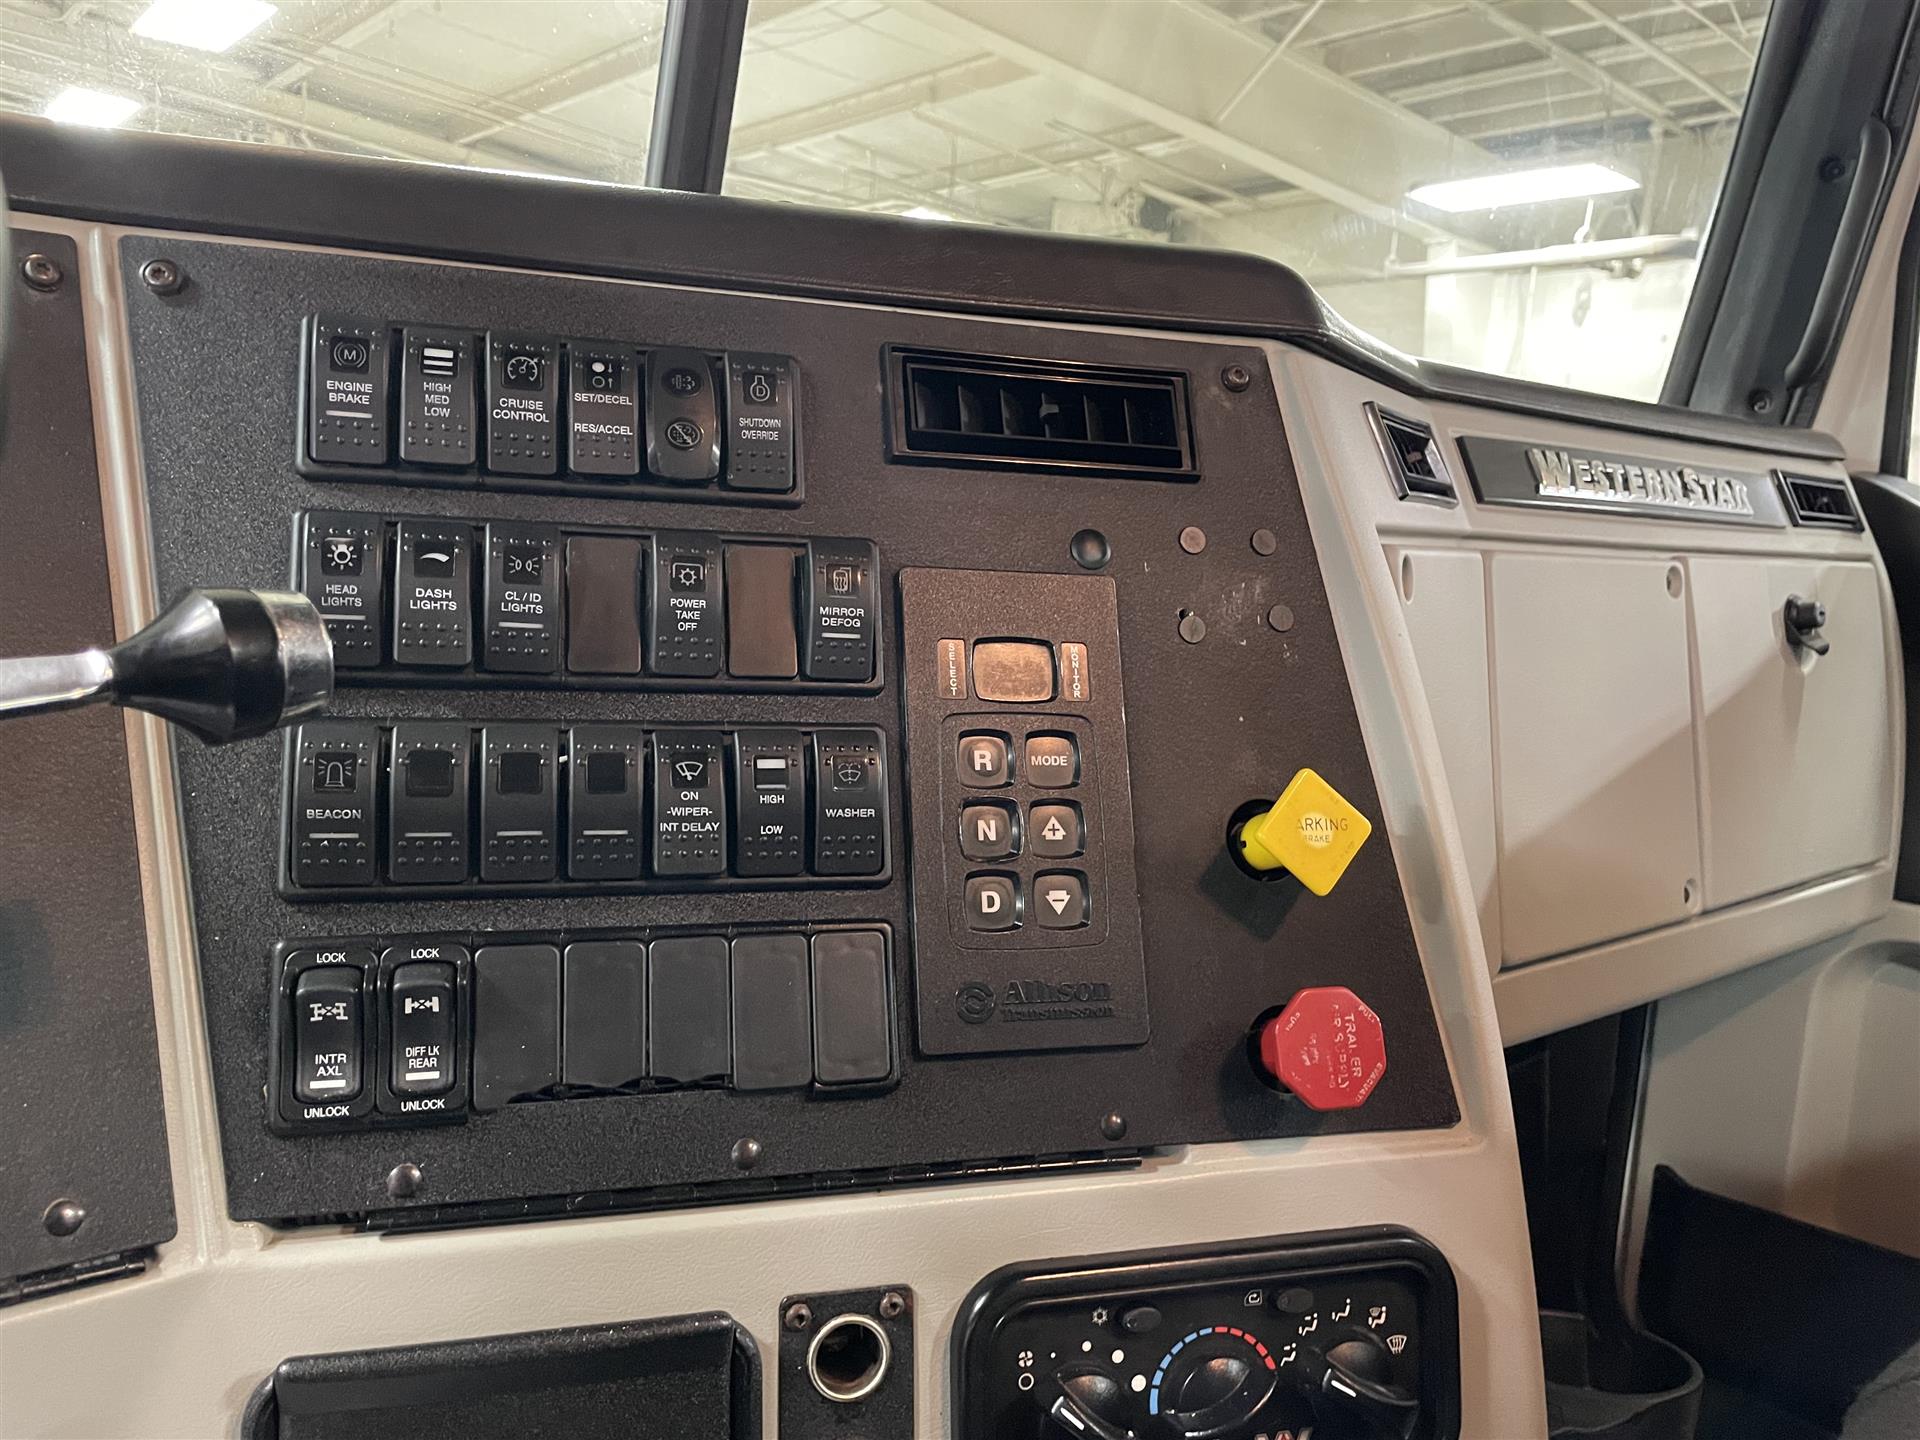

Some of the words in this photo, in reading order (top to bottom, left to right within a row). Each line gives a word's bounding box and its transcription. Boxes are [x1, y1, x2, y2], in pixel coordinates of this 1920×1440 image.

[326, 380, 373, 393] ENGINE
[423, 382, 452, 393] HIGH
[328, 392, 370, 405] BRAKE
[424, 394, 450, 405] MED
[574, 393, 633, 406] SET/DECEL
[499, 398, 544, 411] CRUISE
[424, 406, 451, 418] LOW
[492, 410, 550, 423] CONTROL
[739, 417, 782, 428] SHUTDOWN
[574, 423, 633, 435] RES/ACCEL
[741, 430, 779, 441] OVERRIDE
[325, 584, 358, 595] HEAD
[415, 588, 452, 599] DASH
[321, 596, 363, 607] LIGHTS
[504, 591, 521, 601] CL
[529, 593, 542, 602] ID
[409, 600, 457, 611] LIGHTS
[501, 602, 544, 614] LIGHTS
[670, 598, 707, 609] POWER
[675, 610, 701, 620] TAKE
[819, 606, 865, 617] MIRROR
[677, 621, 698, 632] OFF
[821, 617, 862, 628] DEFOG
[949, 643, 958, 696] SELECT
[1070, 645, 1081, 698] MONITOR
[973, 750, 993, 771] R
[1031, 755, 1068, 767] MODE
[680, 791, 699, 801] ON
[759, 794, 785, 804] HIGH
[306, 809, 362, 820] BEACON
[825, 808, 876, 818] WASHER
[659, 822, 680, 832] INT
[681, 822, 720, 832] DELAY
[760, 825, 784, 835] LOW
[977, 819, 997, 841] N
[981, 891, 1001, 913] D
[316, 952, 346, 964] LOCK
[411, 948, 440, 959] LOCK
[1344, 1013, 1362, 1078] TRAIER
[405, 1046, 427, 1058] DIFF
[428, 1045, 440, 1056] LK
[315, 1053, 347, 1065] INTR
[408, 1058, 437, 1069] REAR
[316, 1065, 342, 1077] AXL
[400, 1099, 445, 1112] UNLOCK
[304, 1106, 350, 1119] UNLOCK
